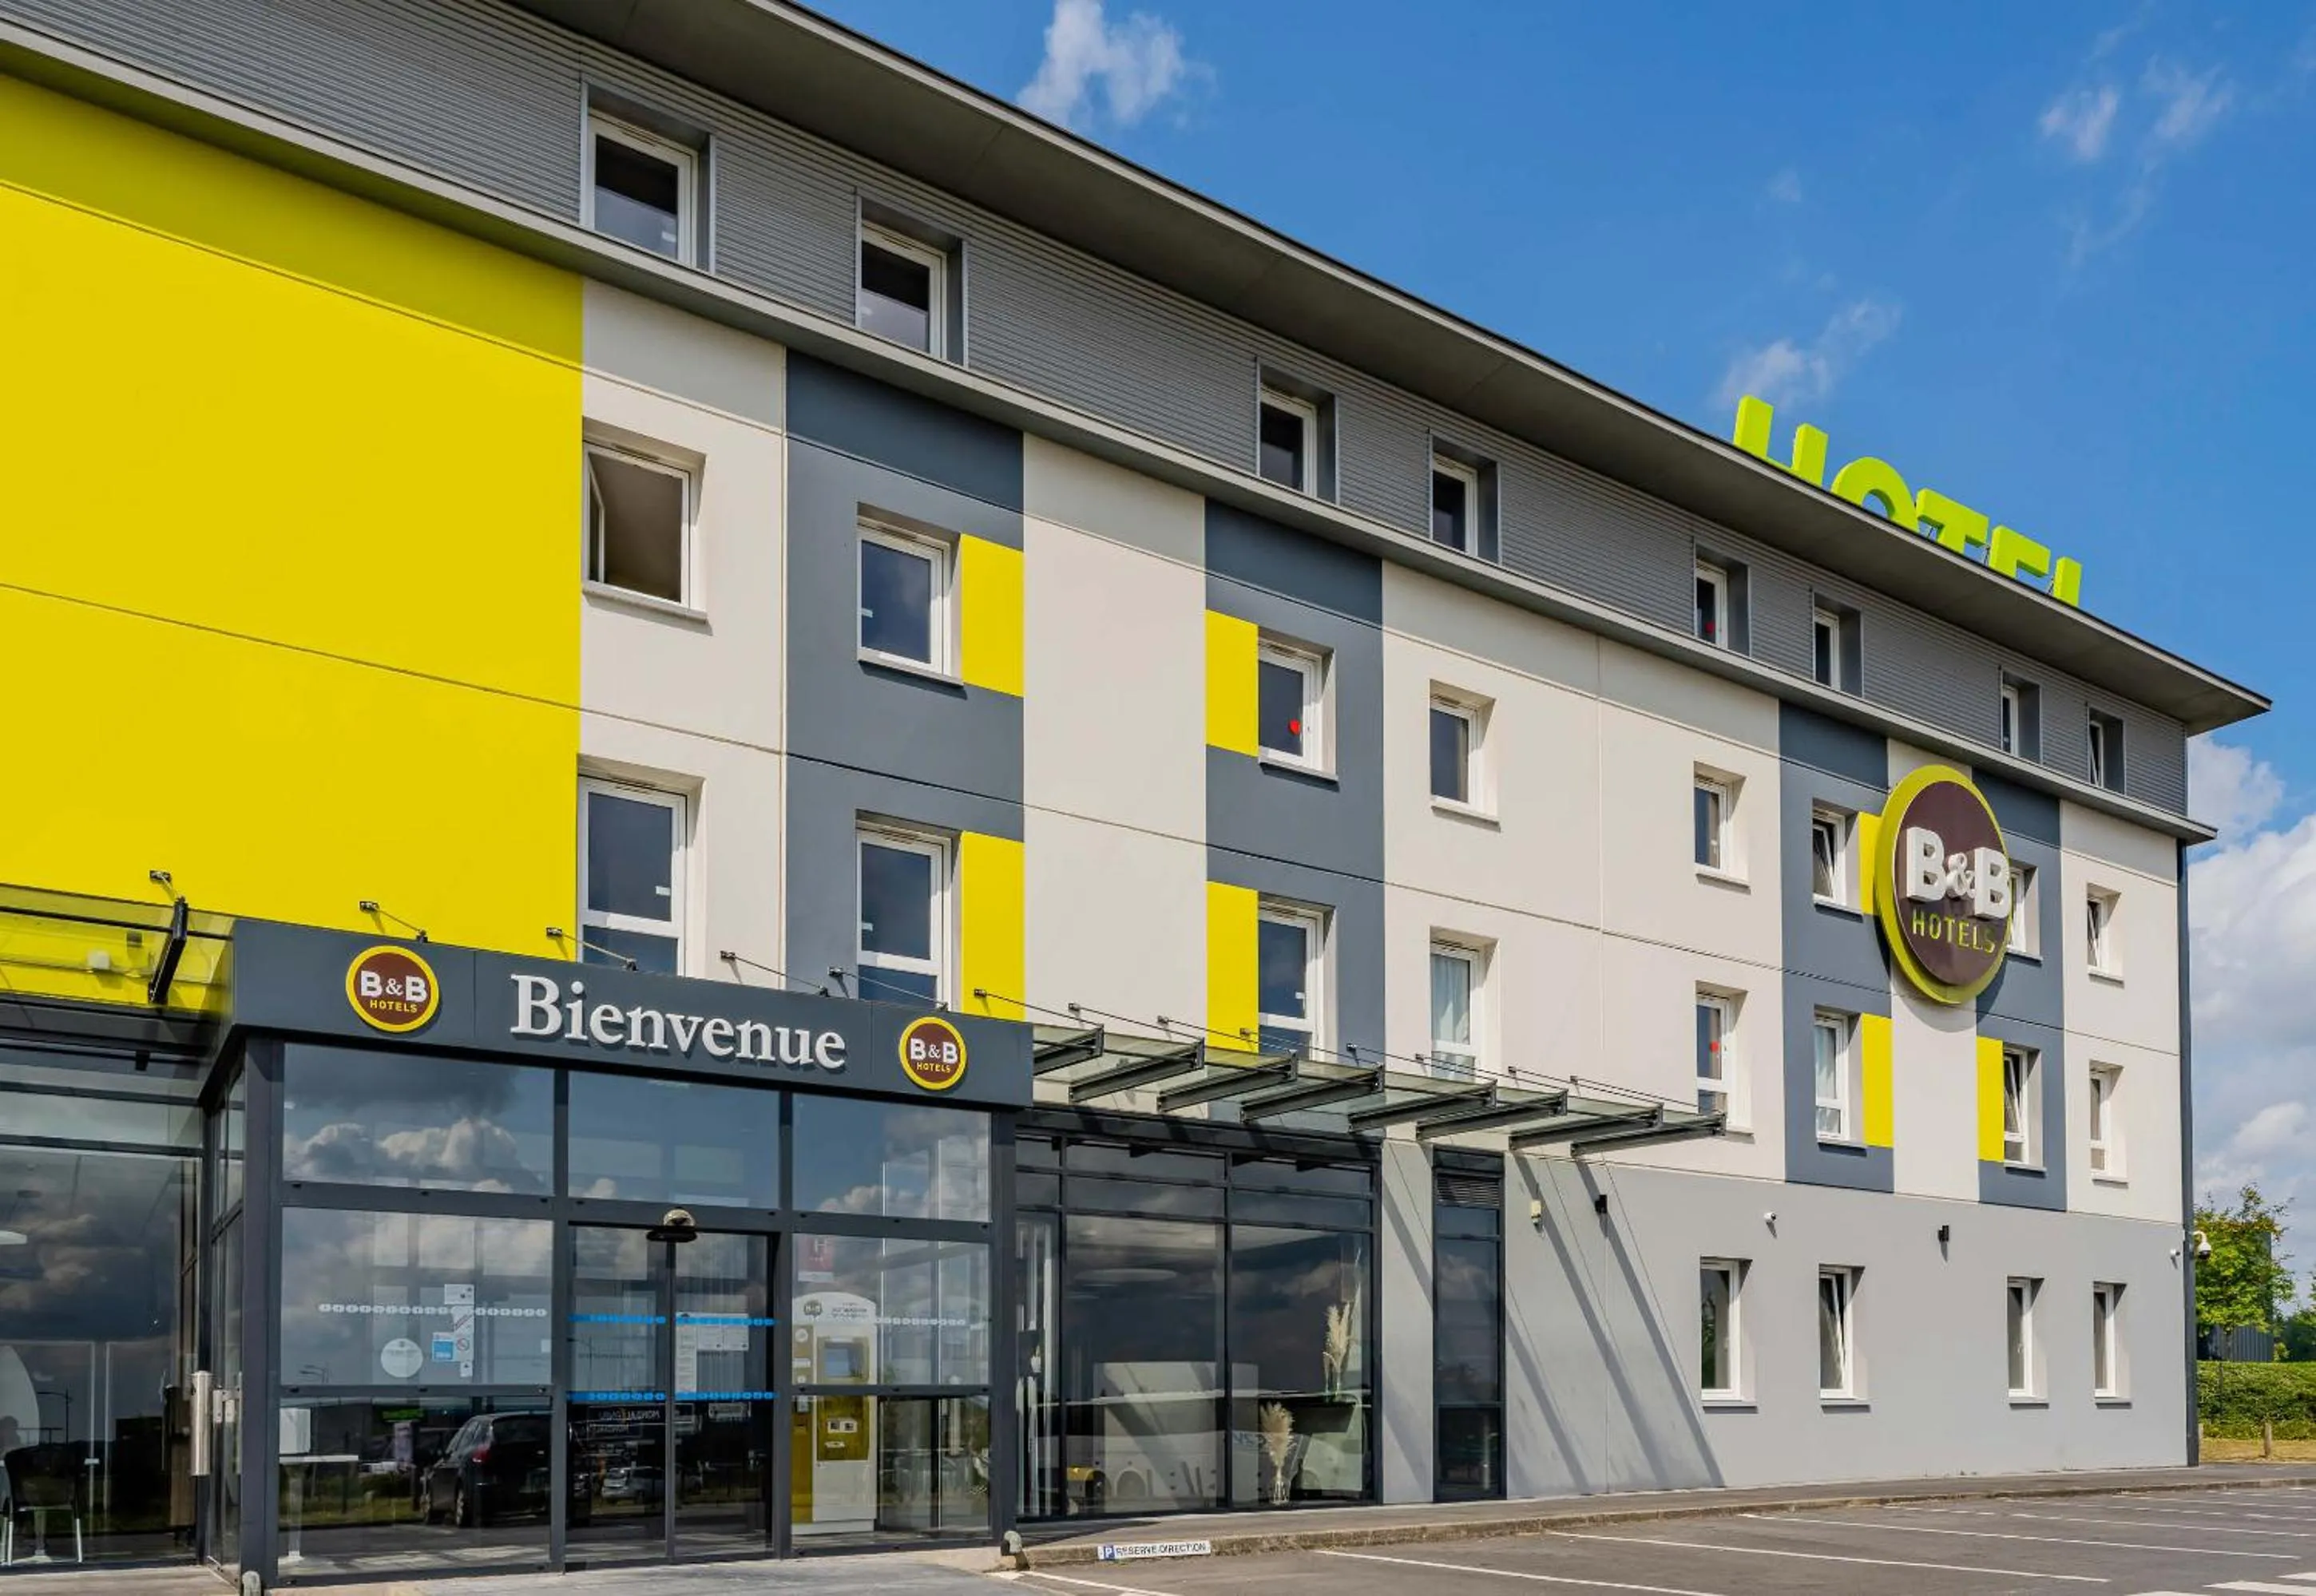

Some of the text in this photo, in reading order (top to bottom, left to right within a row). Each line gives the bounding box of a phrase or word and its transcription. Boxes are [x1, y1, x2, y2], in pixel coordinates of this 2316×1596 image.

[1906, 826, 2011, 918] B&B
[1911, 909, 1995, 954] HOTELS
[360, 970, 427, 1003] B&B
[370, 999, 418, 1013] HOTELS
[510, 972, 847, 1070] Bienvenue
[910, 1038, 958, 1064] B&B
[916, 1061, 951, 1073] HOTELS
[1158, 1542, 1207, 1554] DIRECTION
